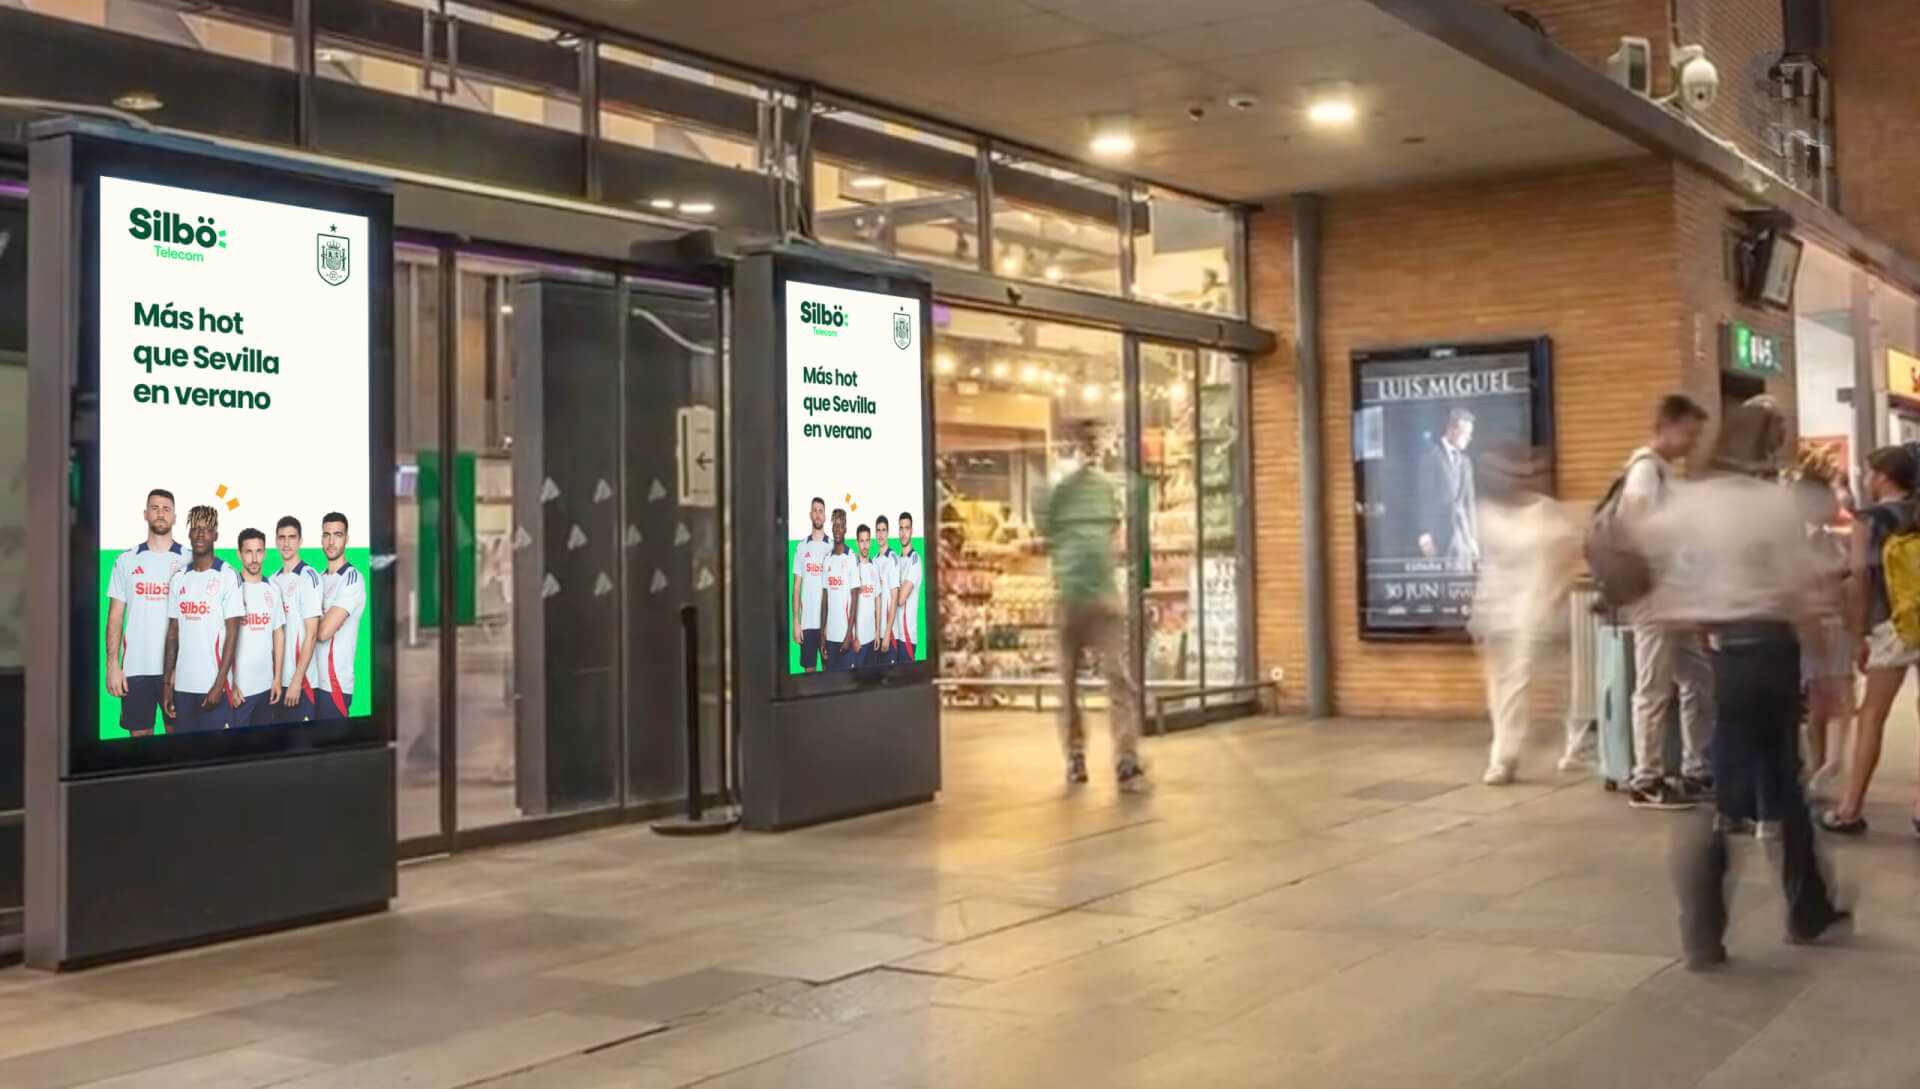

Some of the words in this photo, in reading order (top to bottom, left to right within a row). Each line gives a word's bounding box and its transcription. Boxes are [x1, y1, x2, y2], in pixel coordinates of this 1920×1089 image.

[154, 245, 204, 263] Telecom
[134, 302, 194, 330] Más
[199, 307, 244, 335] hot
[812, 326, 838, 337] Telecom
[133, 345, 189, 373] que
[193, 345, 280, 374] Sevilla
[803, 366, 832, 385] Más
[835, 368, 858, 388] hot
[1378, 377, 1423, 400] LUIS
[1429, 370, 1513, 396] MIGUEL
[133, 384, 169, 404] en
[174, 386, 271, 410] verano
[803, 396, 831, 416] que
[833, 395, 876, 415] Sevilla
[803, 423, 822, 438] en
[824, 424, 872, 440] verano
[1384, 583, 1403, 600] 30
[1405, 583, 1438, 600] JUN
